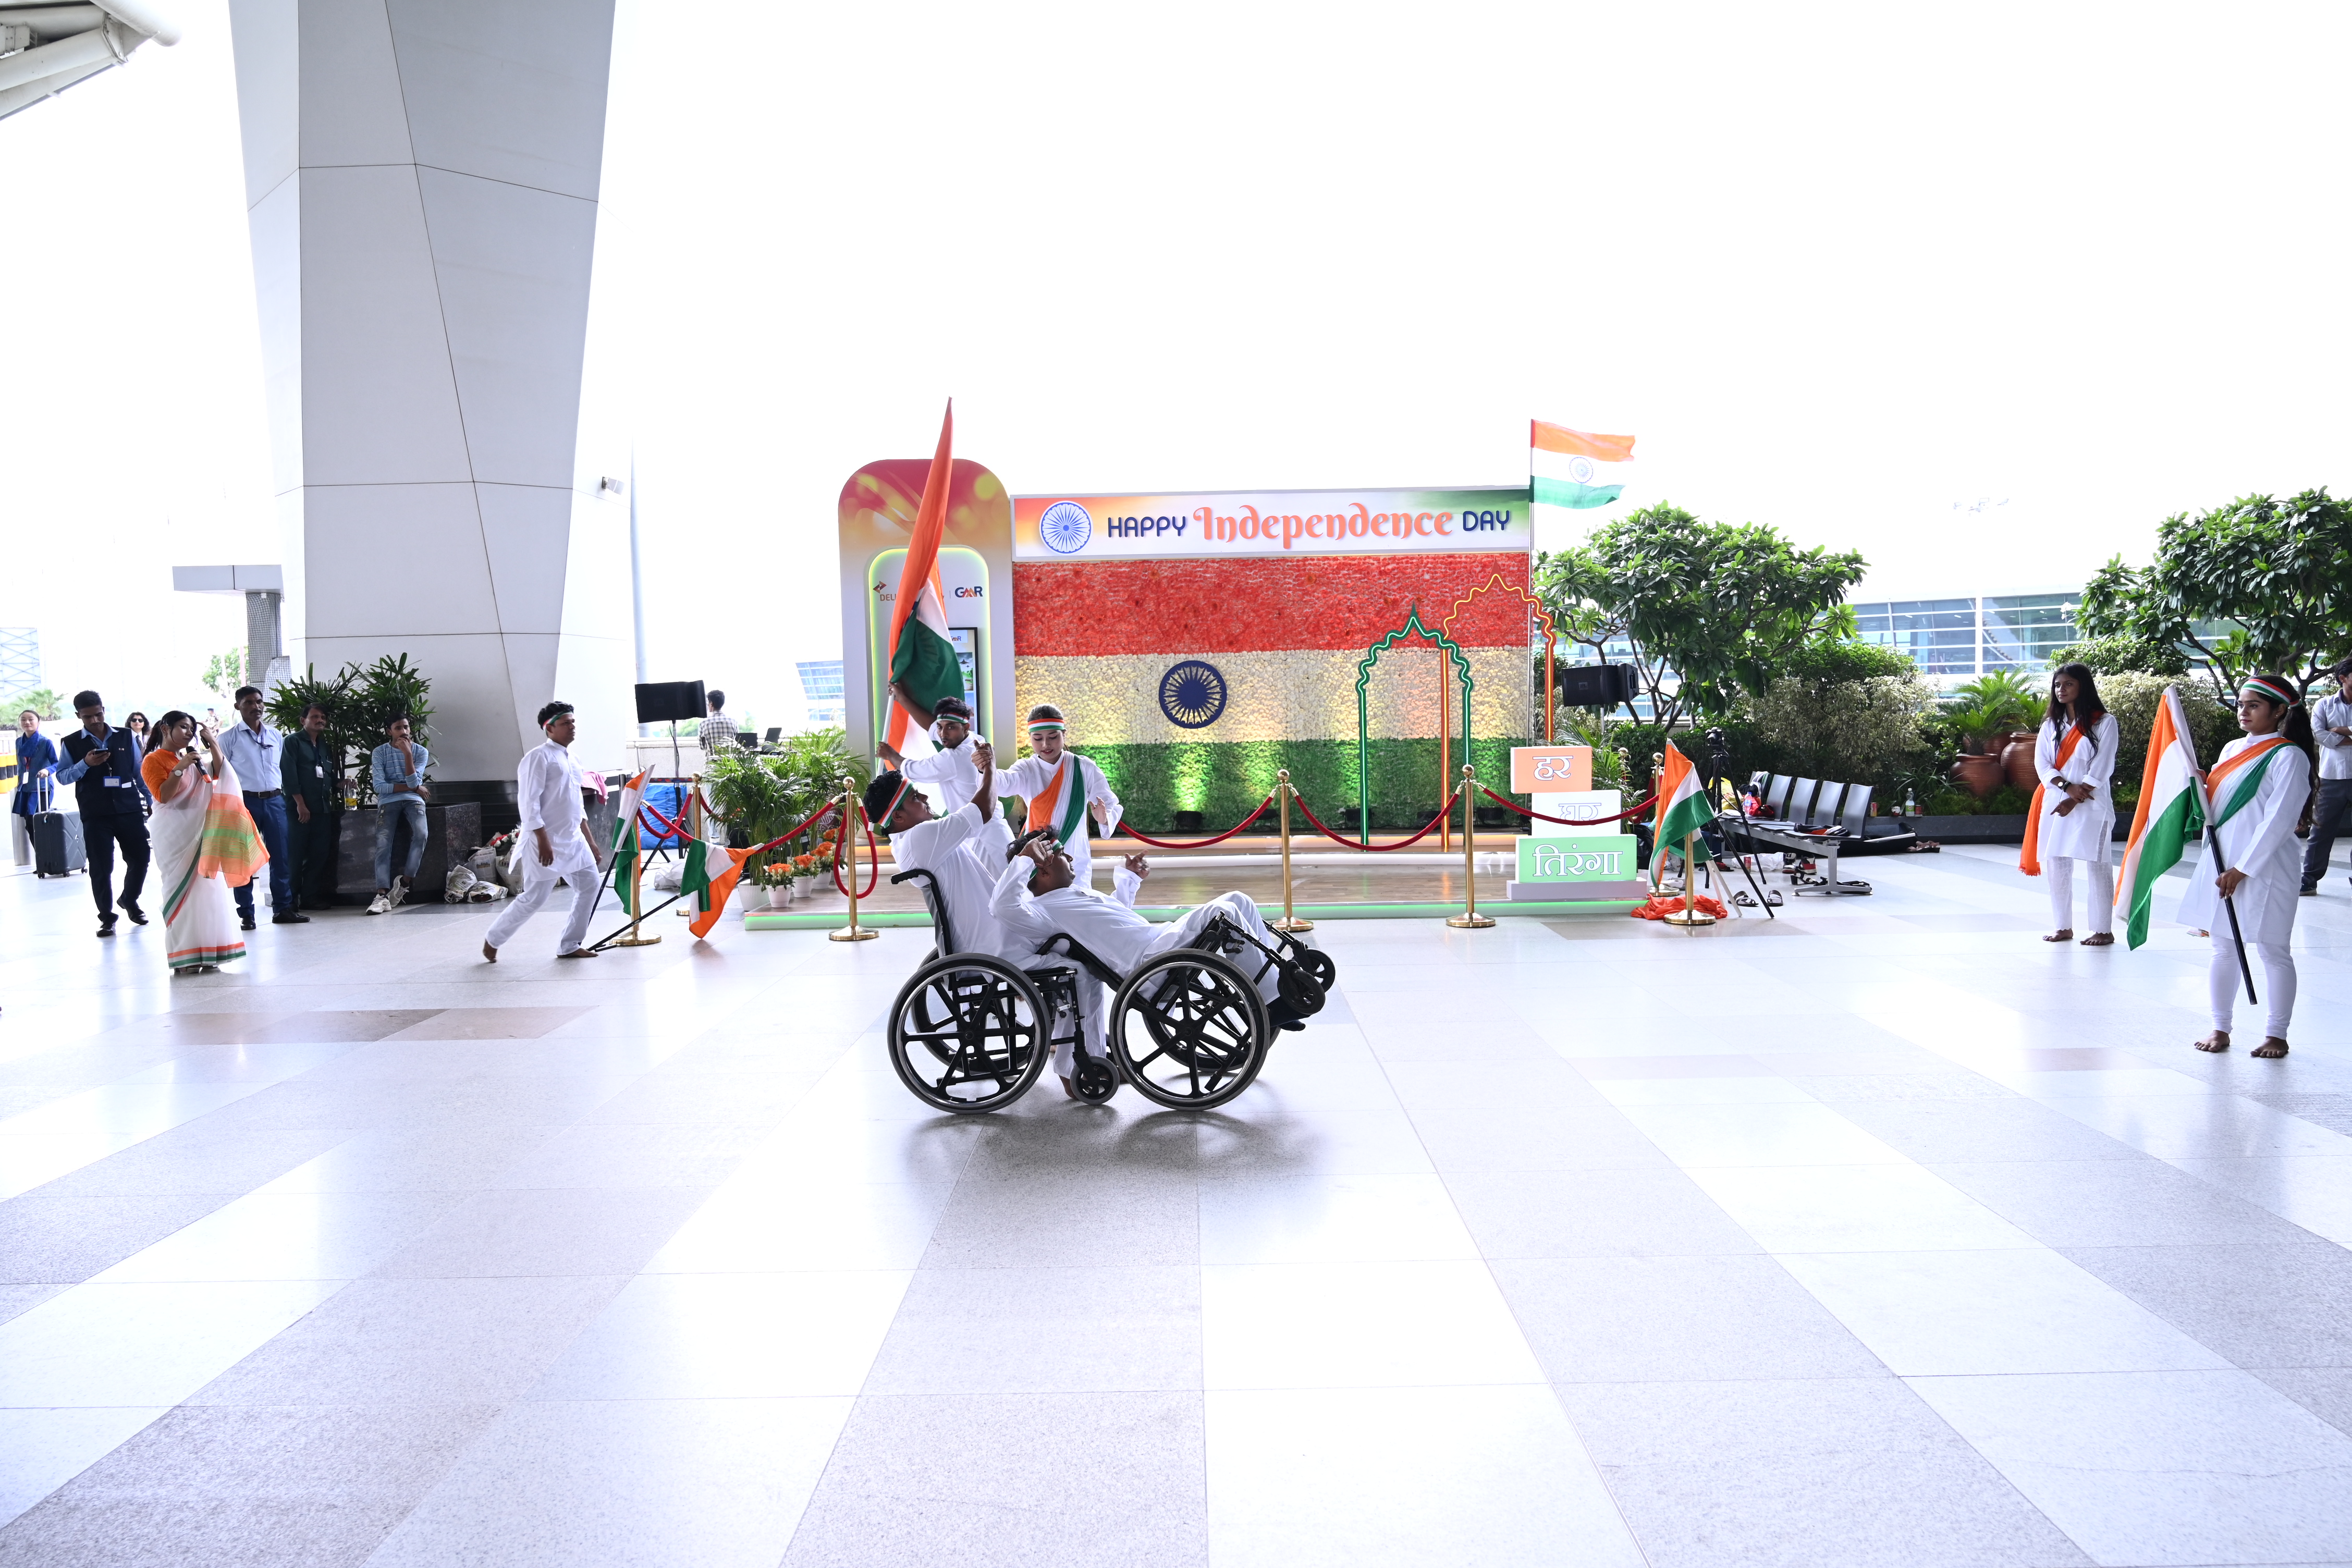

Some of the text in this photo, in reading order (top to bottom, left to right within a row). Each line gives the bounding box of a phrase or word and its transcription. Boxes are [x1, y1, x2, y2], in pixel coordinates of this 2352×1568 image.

[1108, 503, 1510, 549] HAPPY Independence DAY
[954, 586, 983, 598] GMR
[1533, 755, 1573, 780] हर
[1533, 843, 1623, 876] तिरंगा
